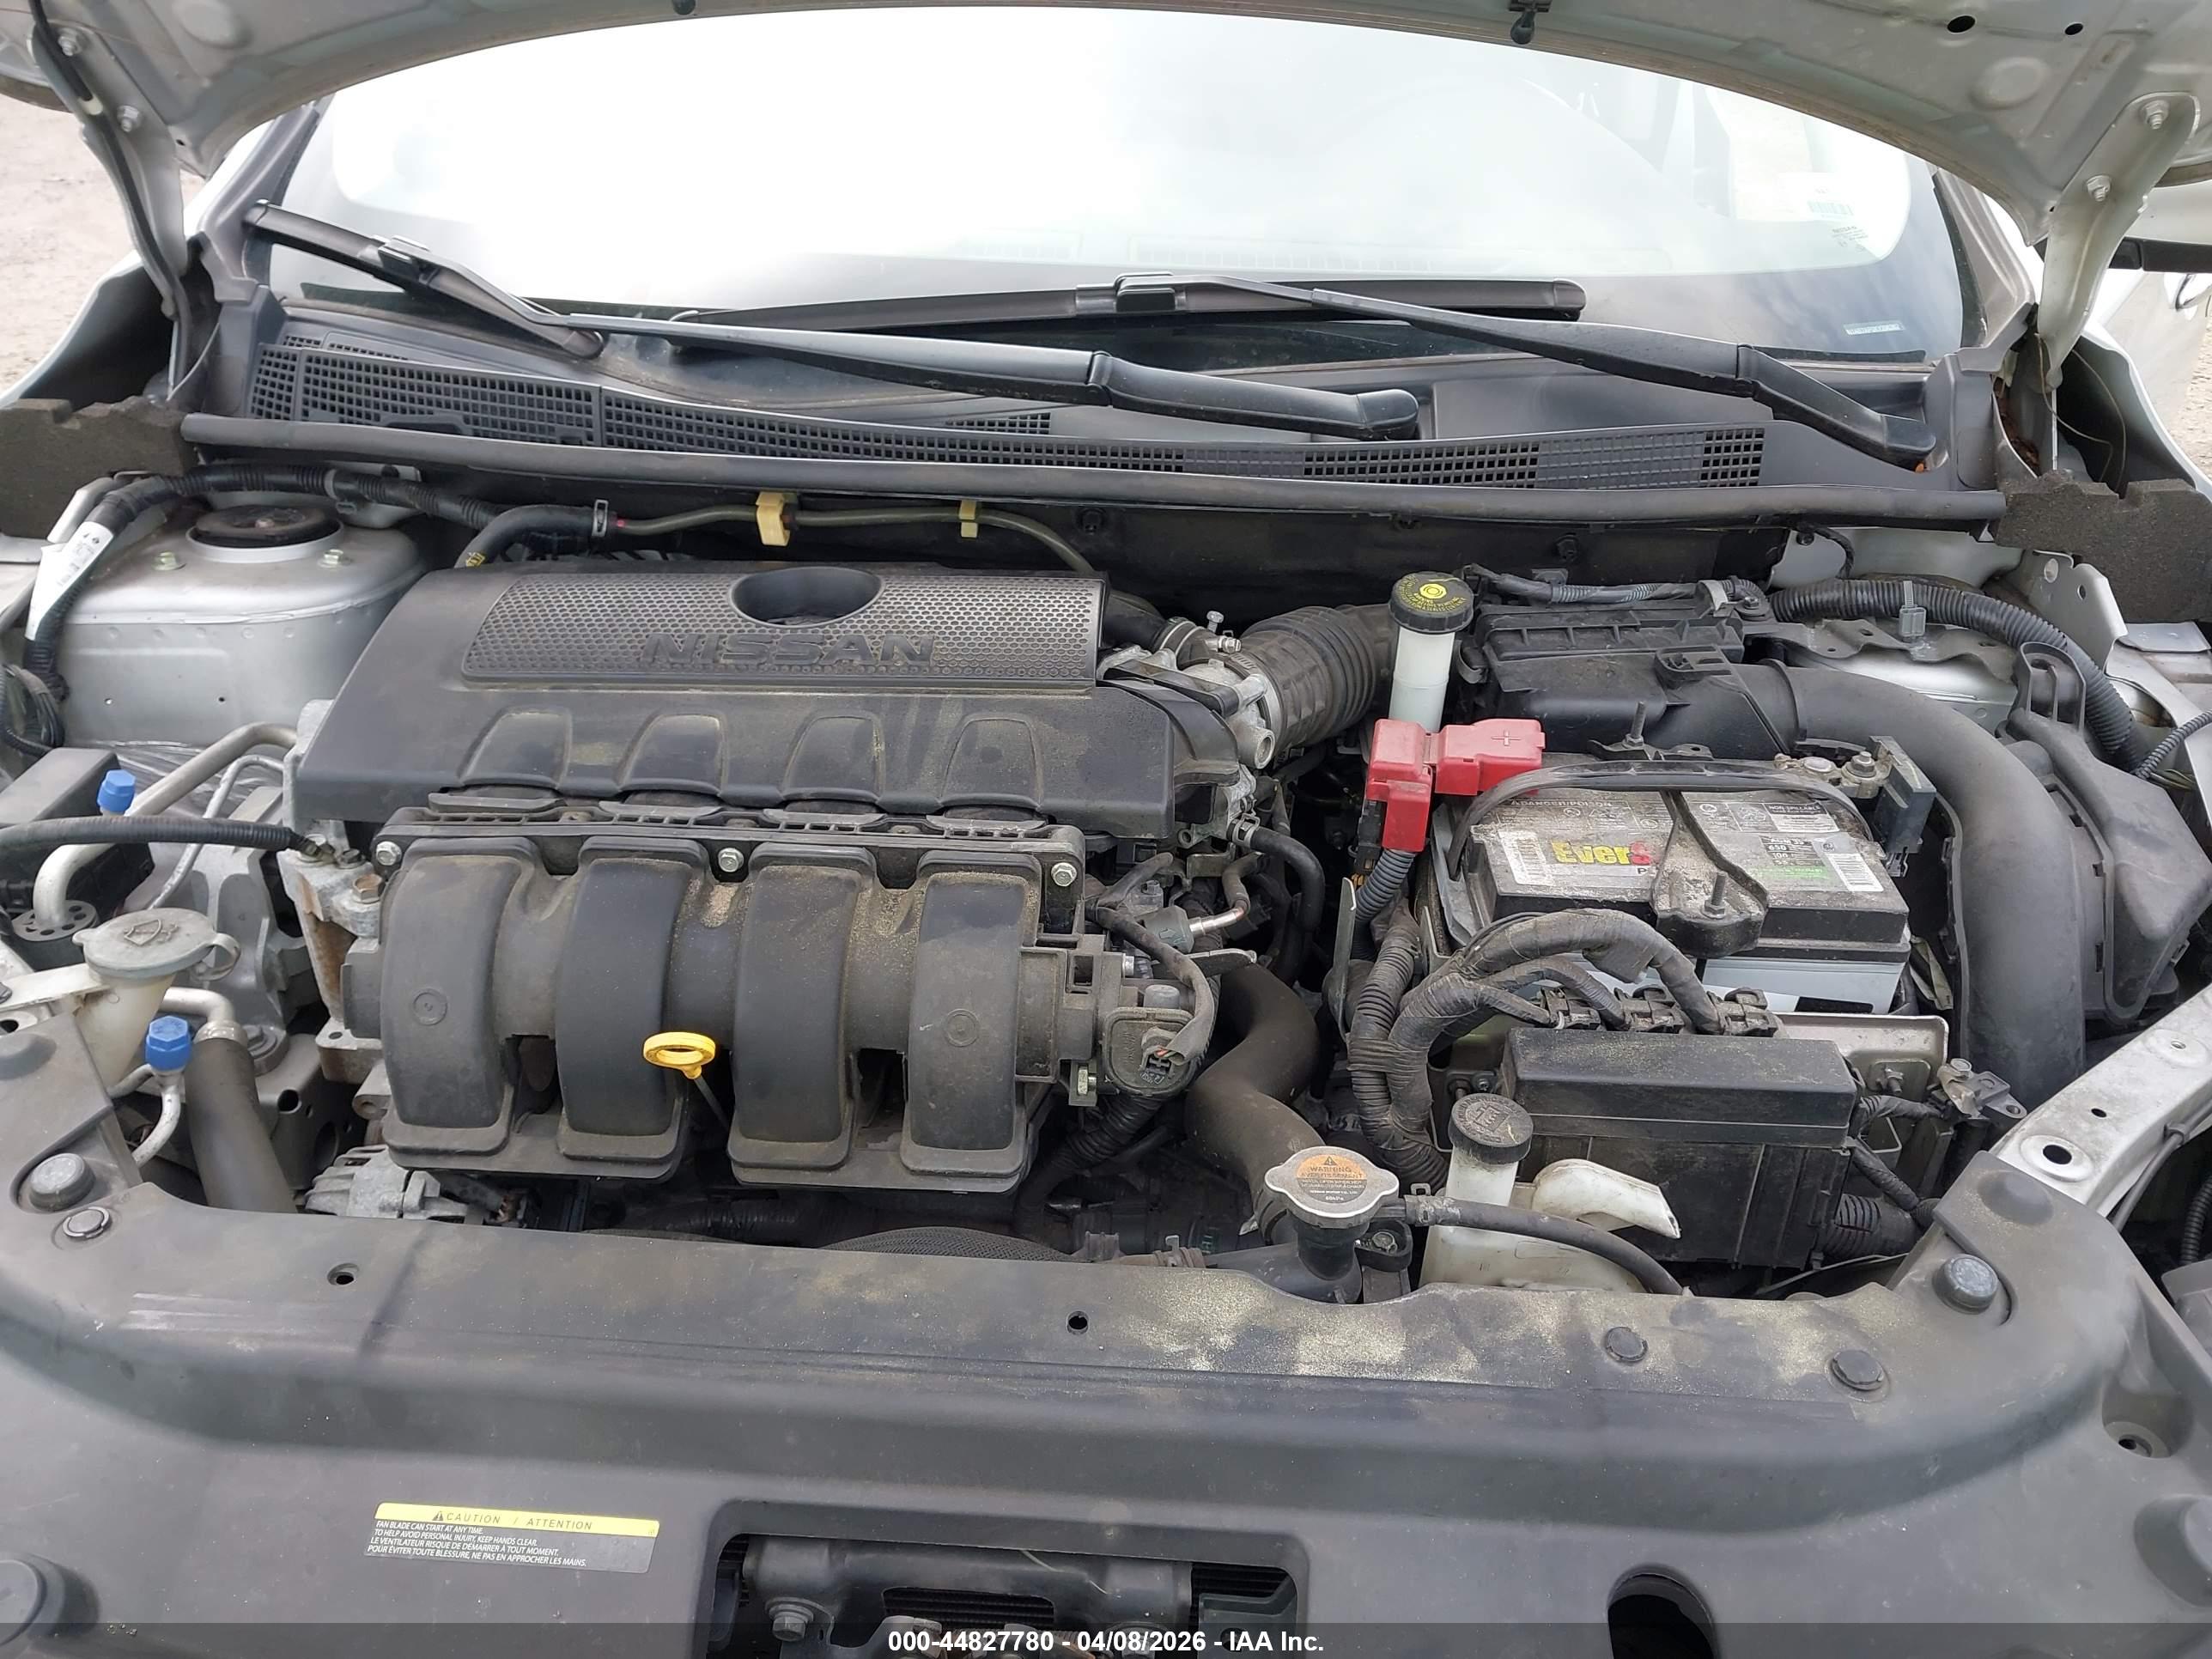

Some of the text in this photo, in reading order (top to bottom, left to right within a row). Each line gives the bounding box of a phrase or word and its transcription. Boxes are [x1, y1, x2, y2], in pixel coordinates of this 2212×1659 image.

[639, 632, 936, 666] NISSAN
[390, 1521, 411, 1529] BLADE
[425, 1523, 445, 1532] START
[446, 1512, 501, 1524] CAUTION
[526, 1518, 592, 1529] ATTENTION
[380, 1537, 425, 1547] VENTILATEUR
[425, 1540, 452, 1550] RISQUE
[507, 1545, 526, 1553] TOUT
[421, 1532, 453, 1540] PERSONAL
[494, 1536, 515, 1545] HANDS
[367, 1545, 388, 1553] POUR
[412, 1547, 434, 1556] TOUTE
[507, 1554, 550, 1565] APPROCHER
